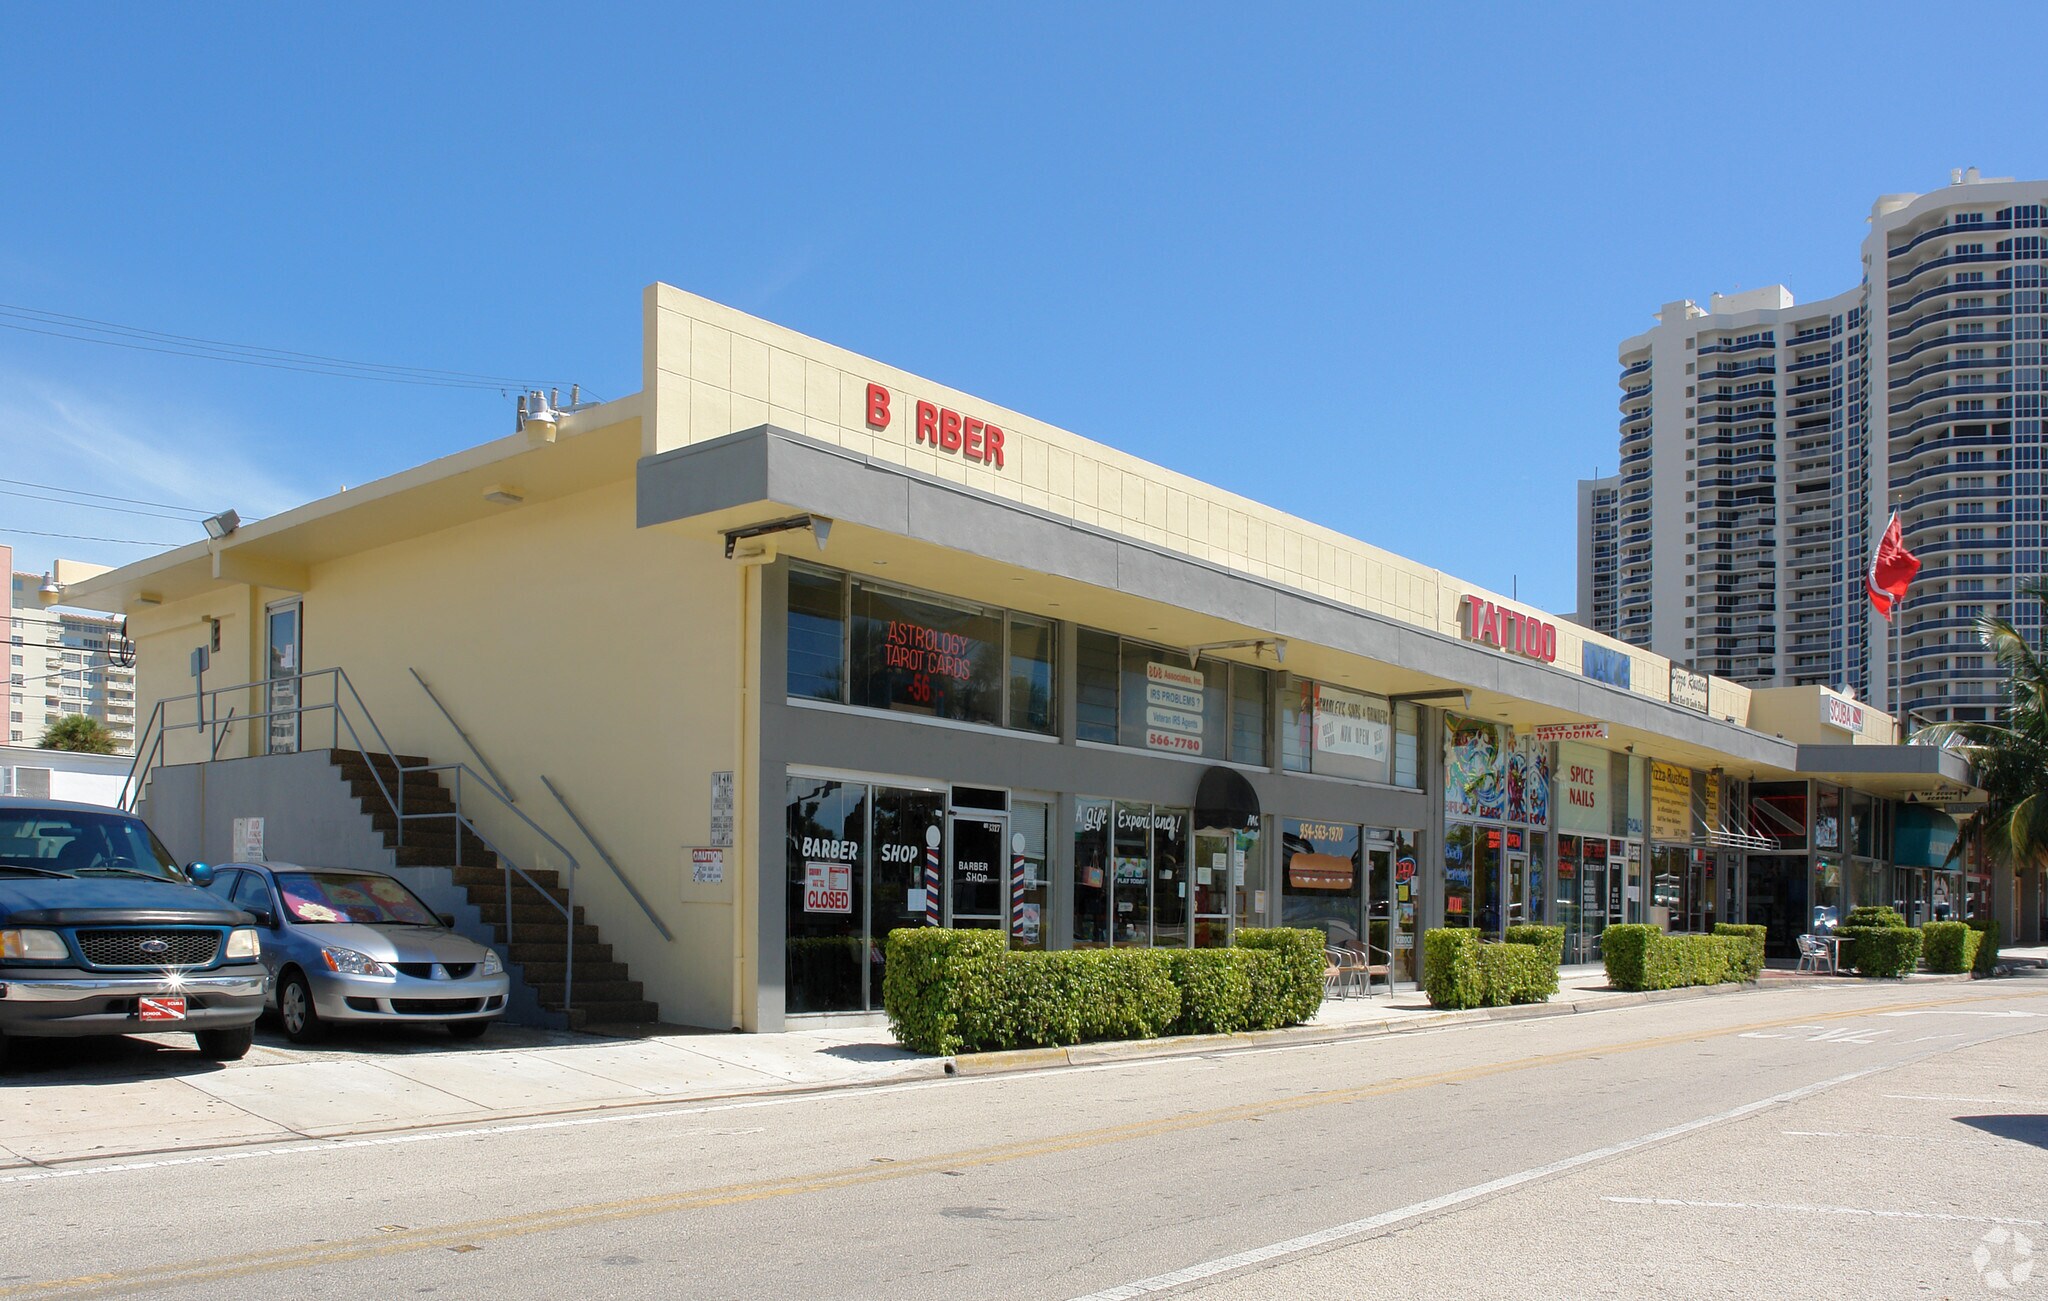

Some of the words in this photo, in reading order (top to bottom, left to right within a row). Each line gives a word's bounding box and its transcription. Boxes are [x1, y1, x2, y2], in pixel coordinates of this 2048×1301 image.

[888, 620, 968, 656] ASTROLOGY
[1465, 594, 1556, 663] TATTOO
[885, 644, 924, 671] TAROT
[928, 652, 970, 680] CARDS
[1151, 689, 1160, 701] IRS
[1162, 692, 1195, 707] PROBLEMS
[1830, 699, 1851, 726] SCUBA
[1150, 733, 1199, 751] 566-7780
[1537, 730, 1603, 741] TATTOOING
[1570, 765, 1594, 786] SPICE
[1569, 788, 1595, 808] NAILS
[1075, 805, 1082, 823] A
[1084, 807, 1107, 832] gift
[1299, 823, 1344, 842] 954-563-1970
[693, 850, 722, 861] CAUTION
[802, 836, 858, 860] BARBER
[881, 843, 918, 863] SHOP
[958, 861, 988, 872] BARBER
[966, 872, 988, 883] SHOP
[808, 890, 849, 909] CLOSED
